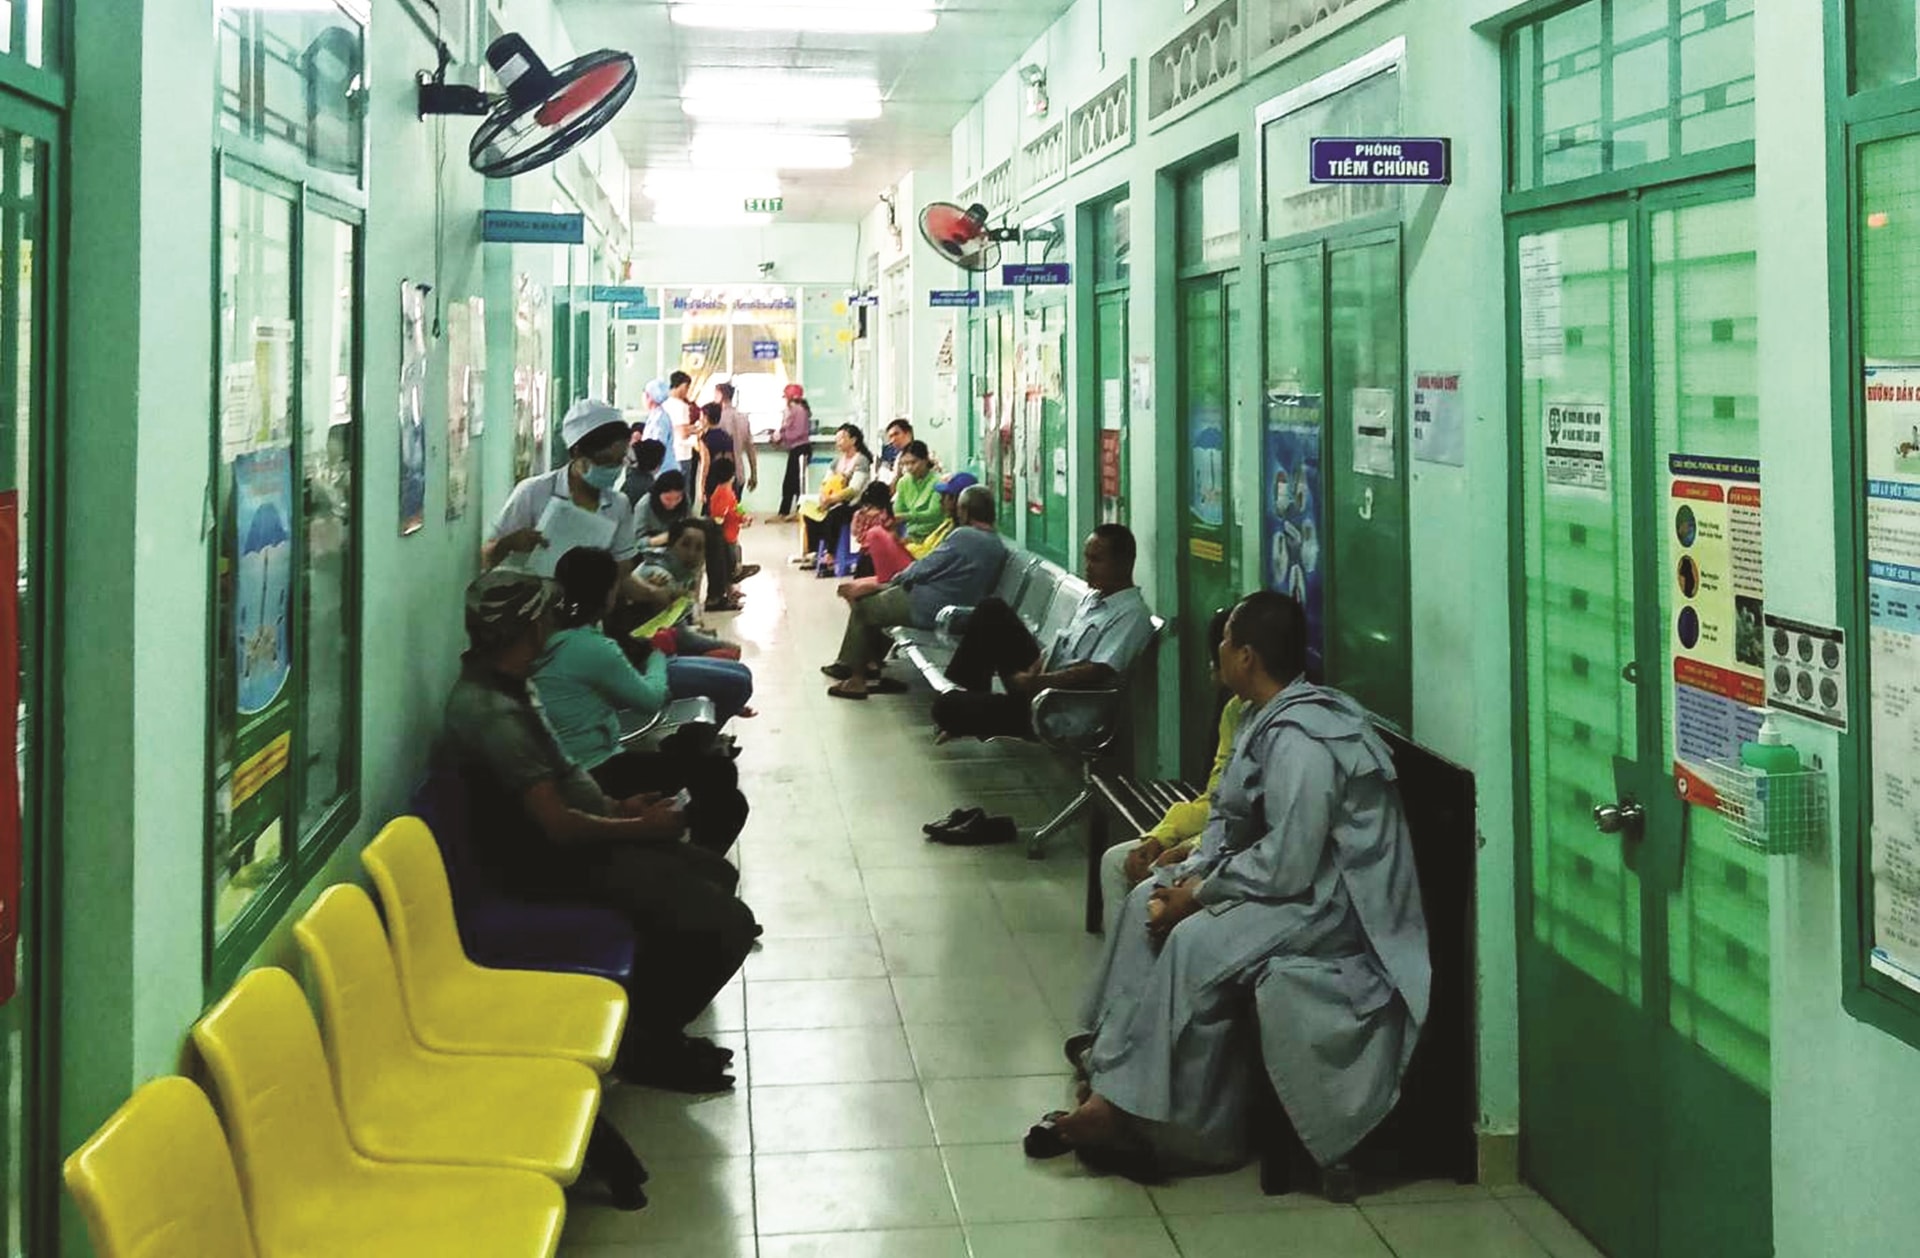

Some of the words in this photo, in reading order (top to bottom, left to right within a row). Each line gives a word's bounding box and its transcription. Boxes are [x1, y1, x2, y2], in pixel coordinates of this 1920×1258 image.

[1328, 157, 1368, 176] TIÊM
[1373, 155, 1430, 176] CHỦNG
[747, 199, 781, 211] EXIT
